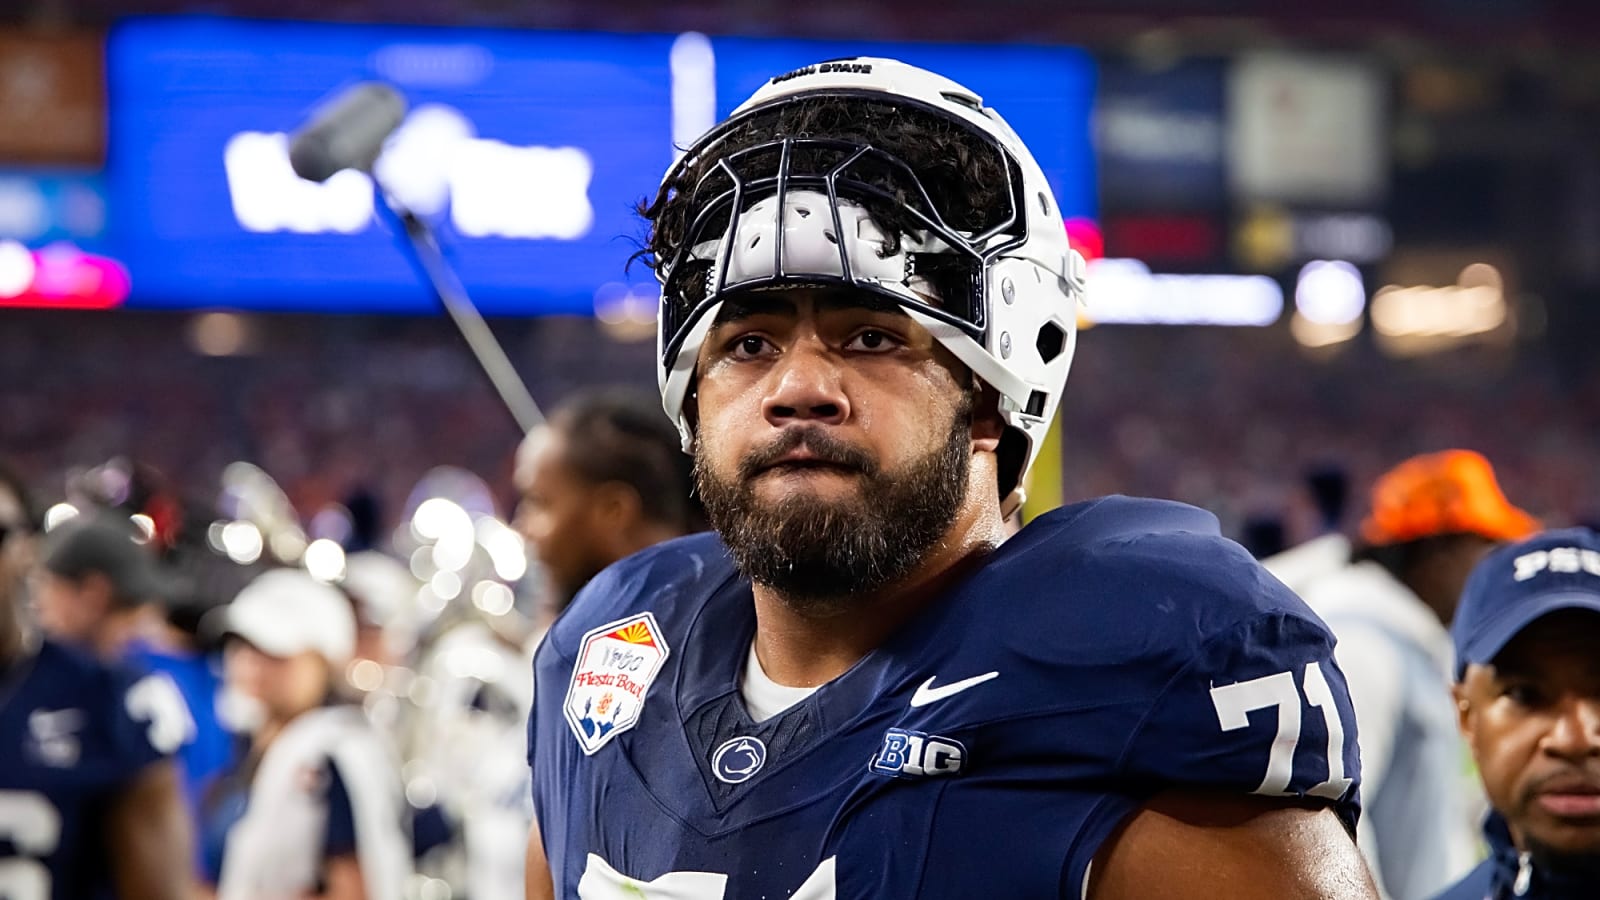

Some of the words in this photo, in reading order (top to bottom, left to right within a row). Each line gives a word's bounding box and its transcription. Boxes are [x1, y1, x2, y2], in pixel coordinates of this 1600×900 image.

[819, 63, 872, 74] STATE
[576, 671, 614, 687] Fiesta
[616, 674, 645, 698] Bowl
[1210, 661, 1353, 800] 71
